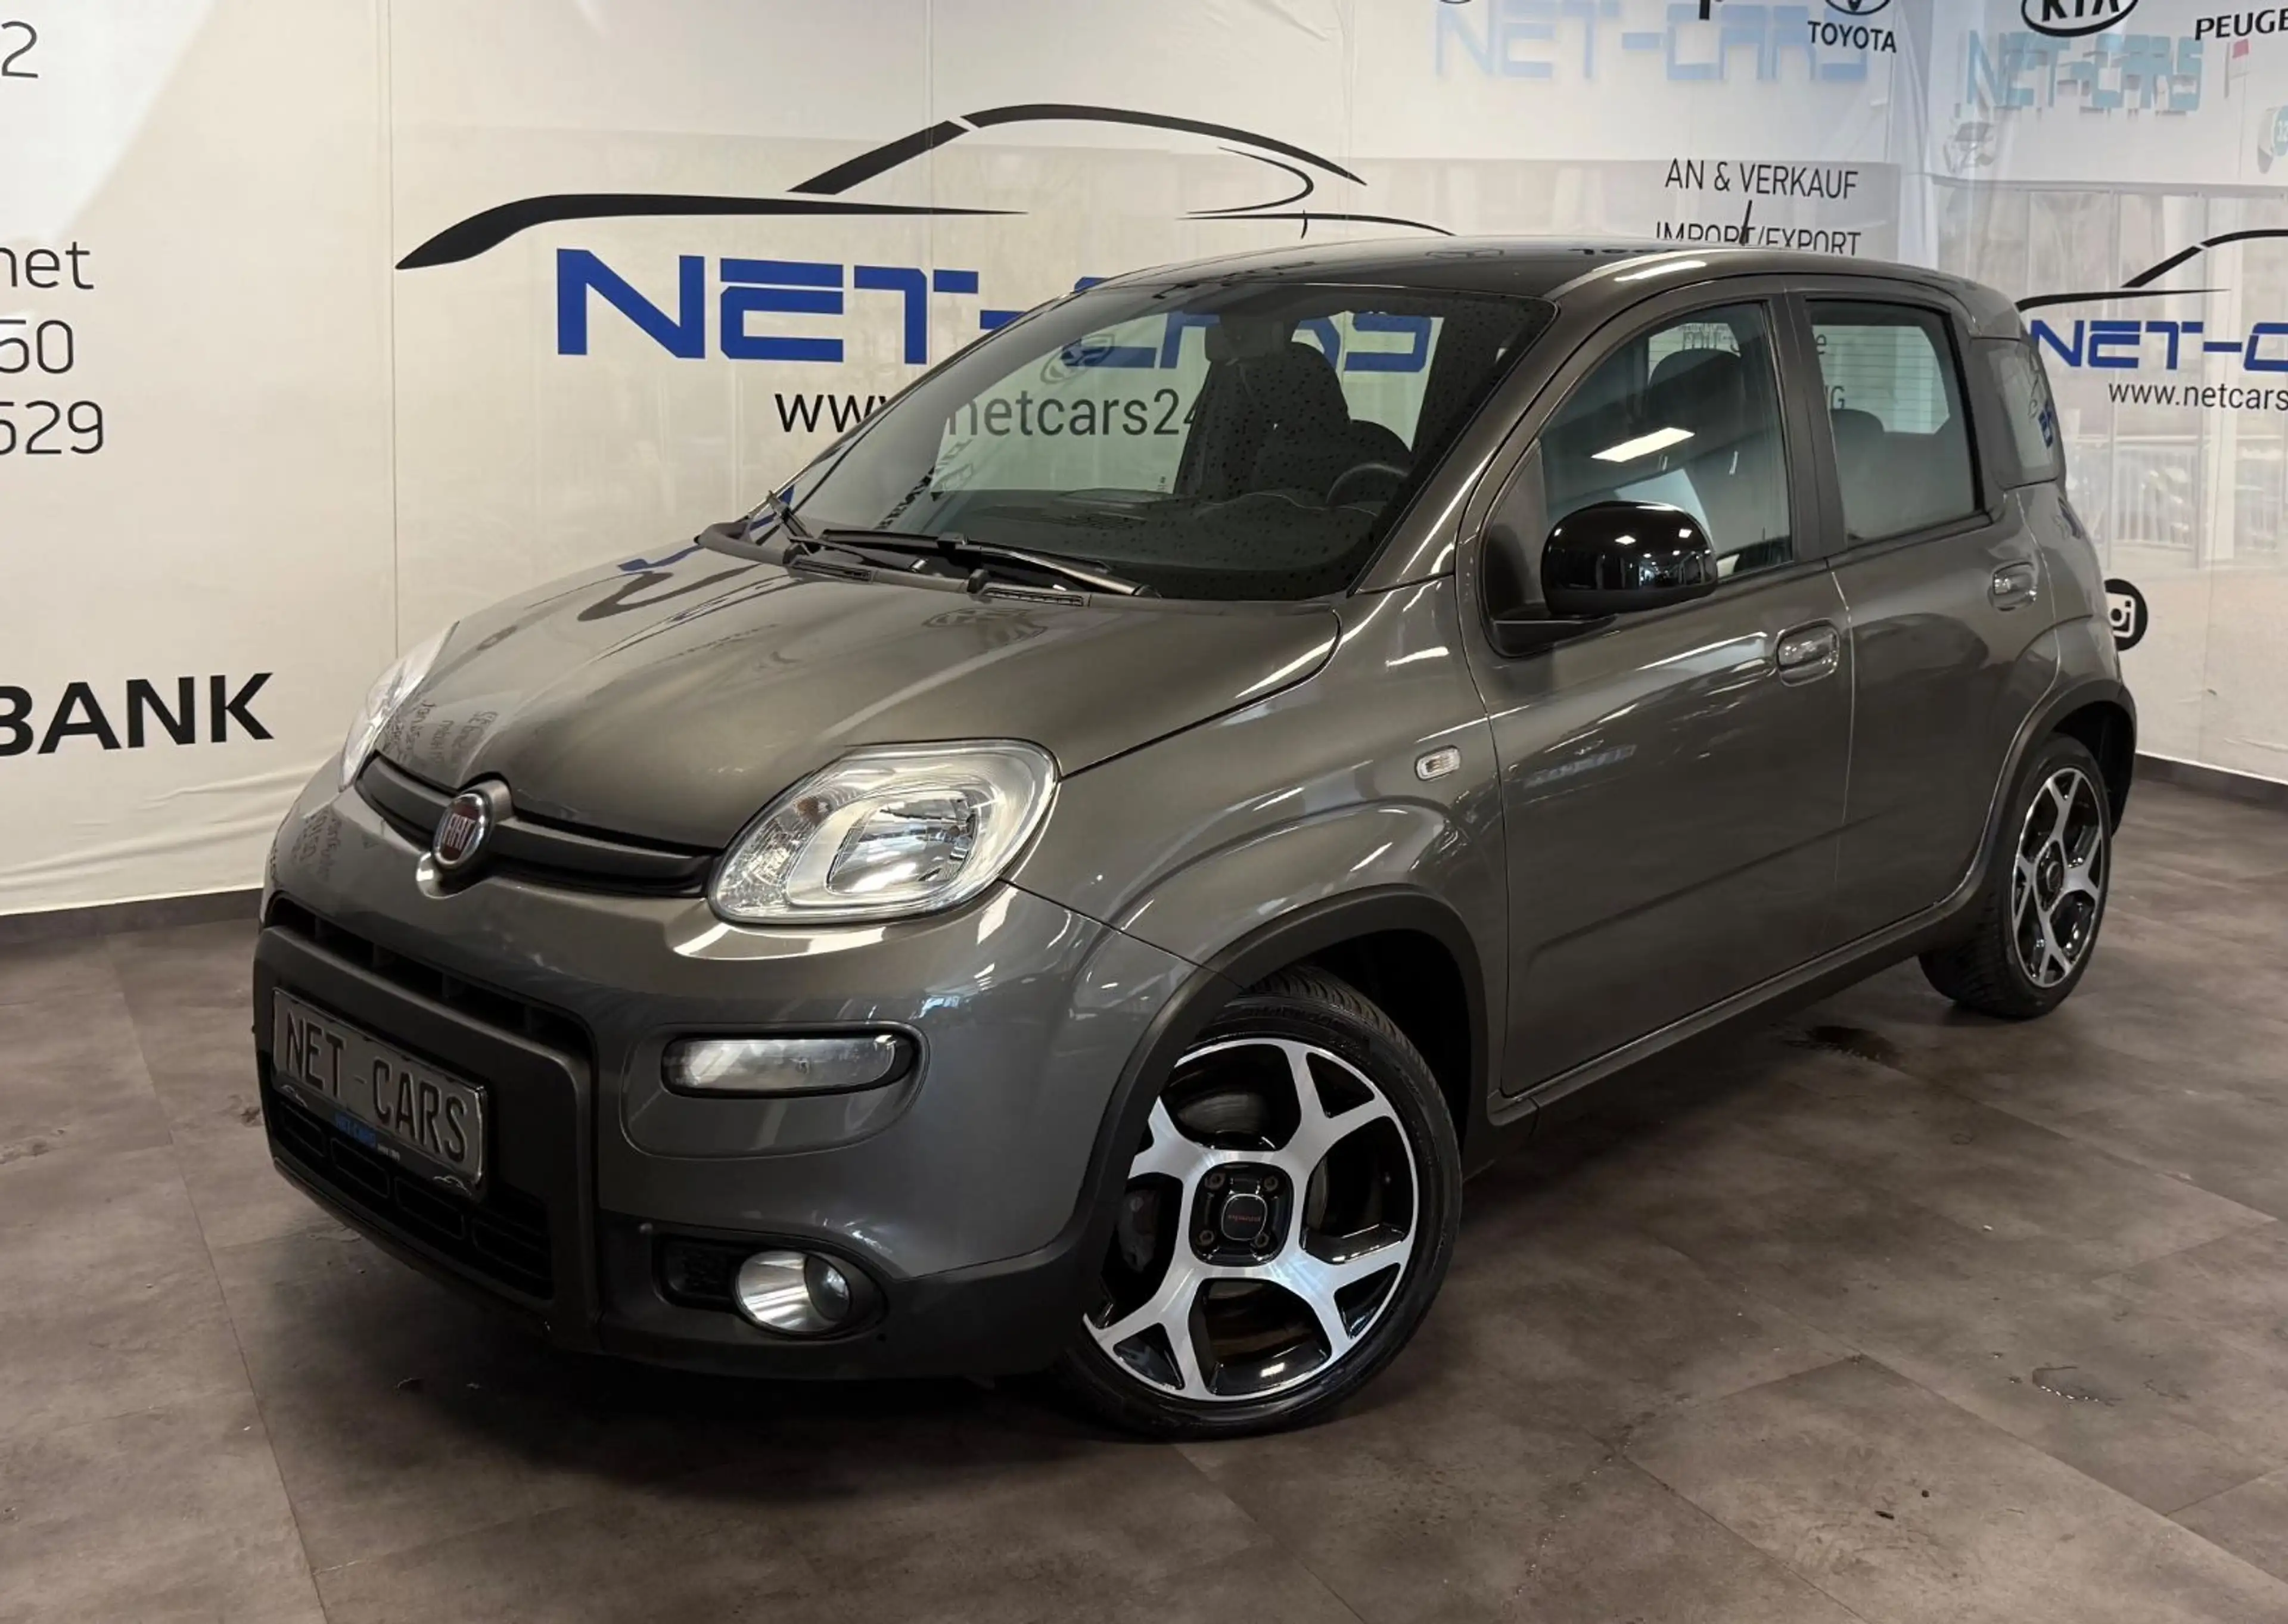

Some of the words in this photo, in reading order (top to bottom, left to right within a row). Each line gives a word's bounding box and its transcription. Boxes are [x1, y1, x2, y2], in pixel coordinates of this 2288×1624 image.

[1, 20, 39, 79] 2
[1807, 21, 1897, 53] TOYOTA
[1665, 158, 1705, 189] AN
[1714, 161, 1730, 191] &
[1739, 162, 1858, 199] VERKAUF
[2109, 382, 2288, 411] www.netcars
[0, 672, 275, 757] BANK
